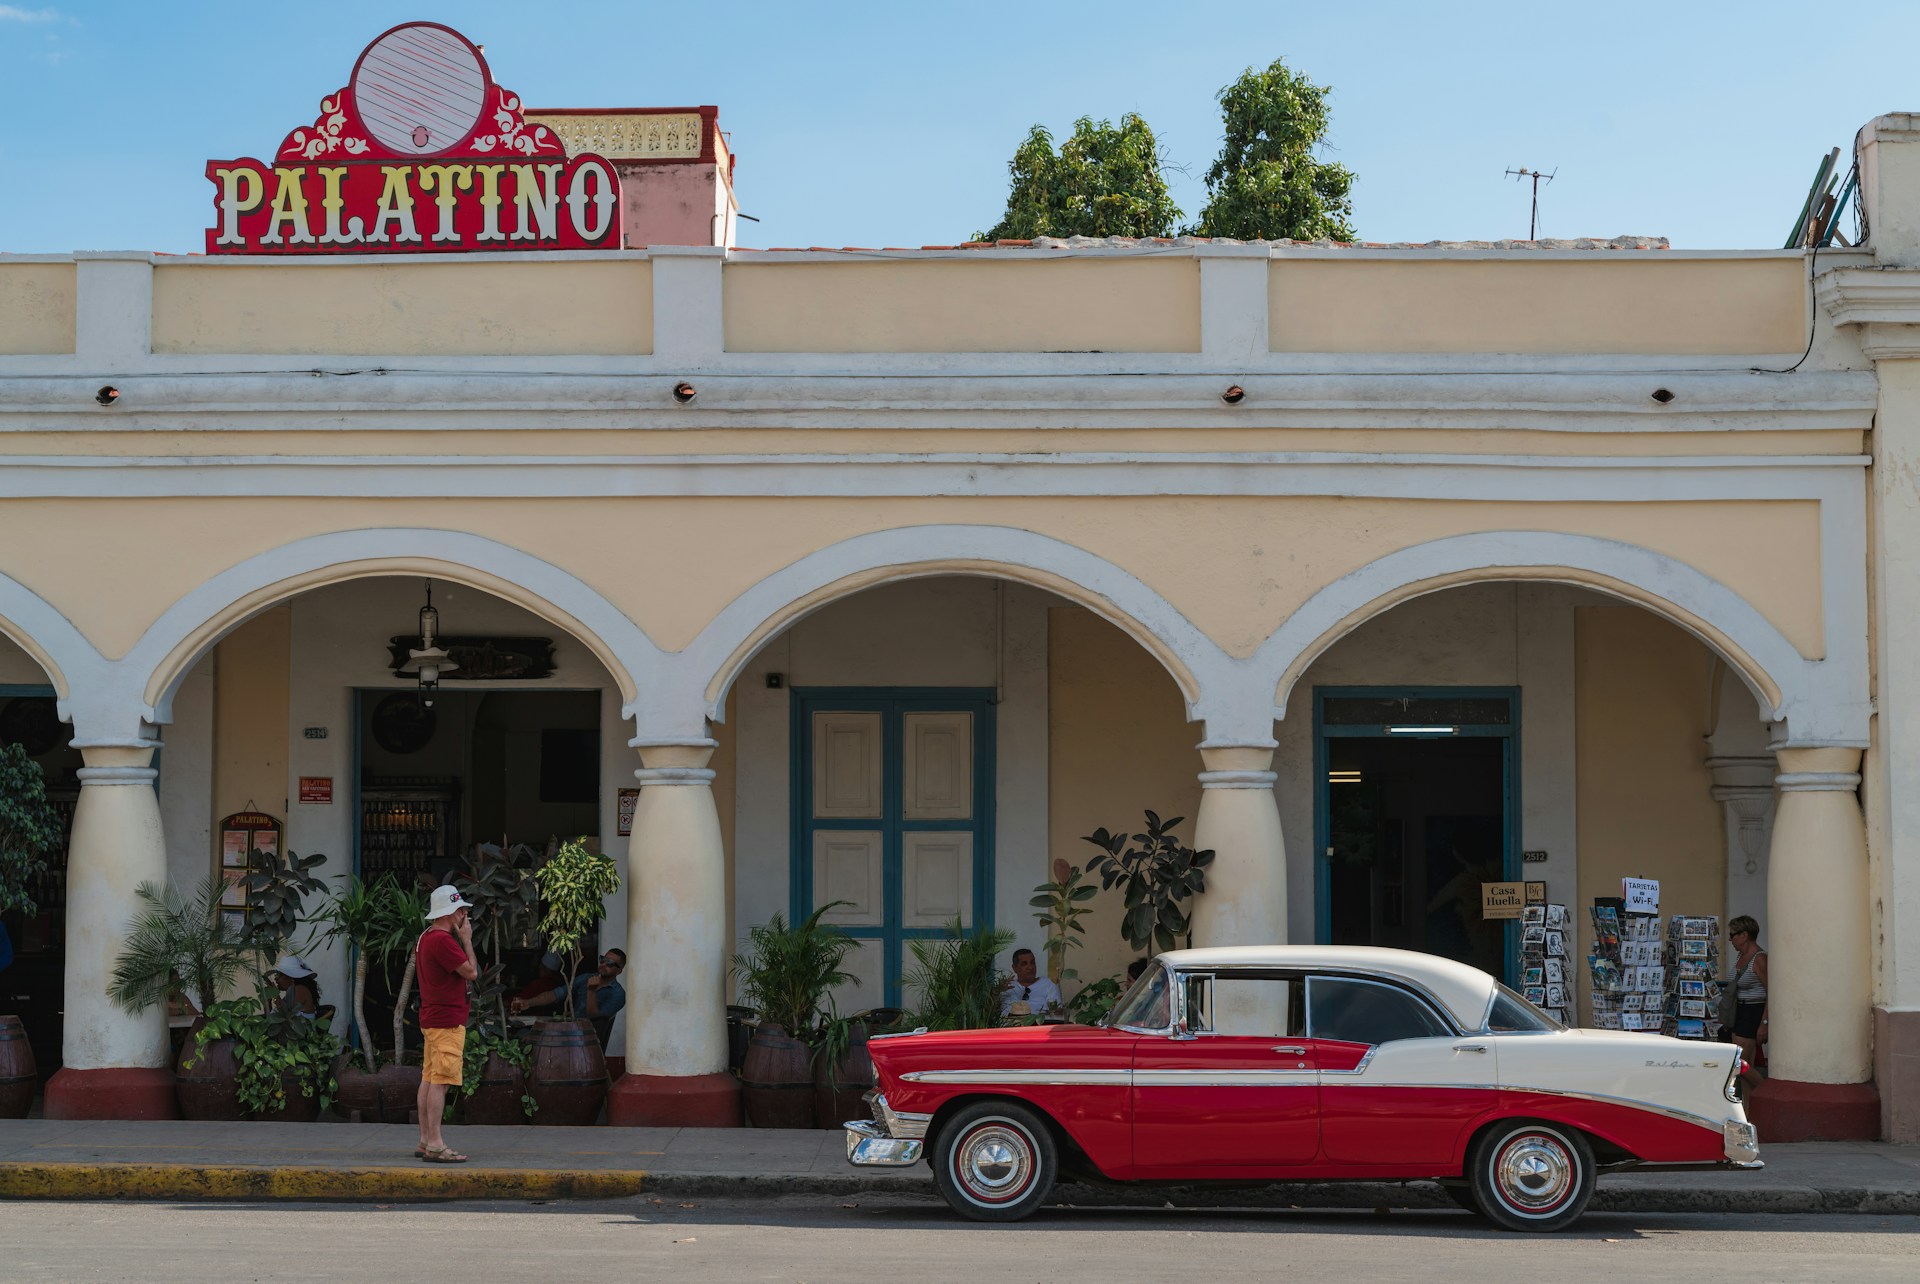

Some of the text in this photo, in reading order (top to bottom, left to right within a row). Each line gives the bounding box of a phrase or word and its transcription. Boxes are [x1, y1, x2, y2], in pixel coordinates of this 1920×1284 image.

[216, 161, 616, 246] PALATINO
[236, 816, 268, 824] PALATINO
[1525, 852, 1545, 861] 2512
[1491, 886, 1516, 896] Casa
[1628, 882, 1658, 891] TARJETAS
[1487, 896, 1521, 906] Huella
